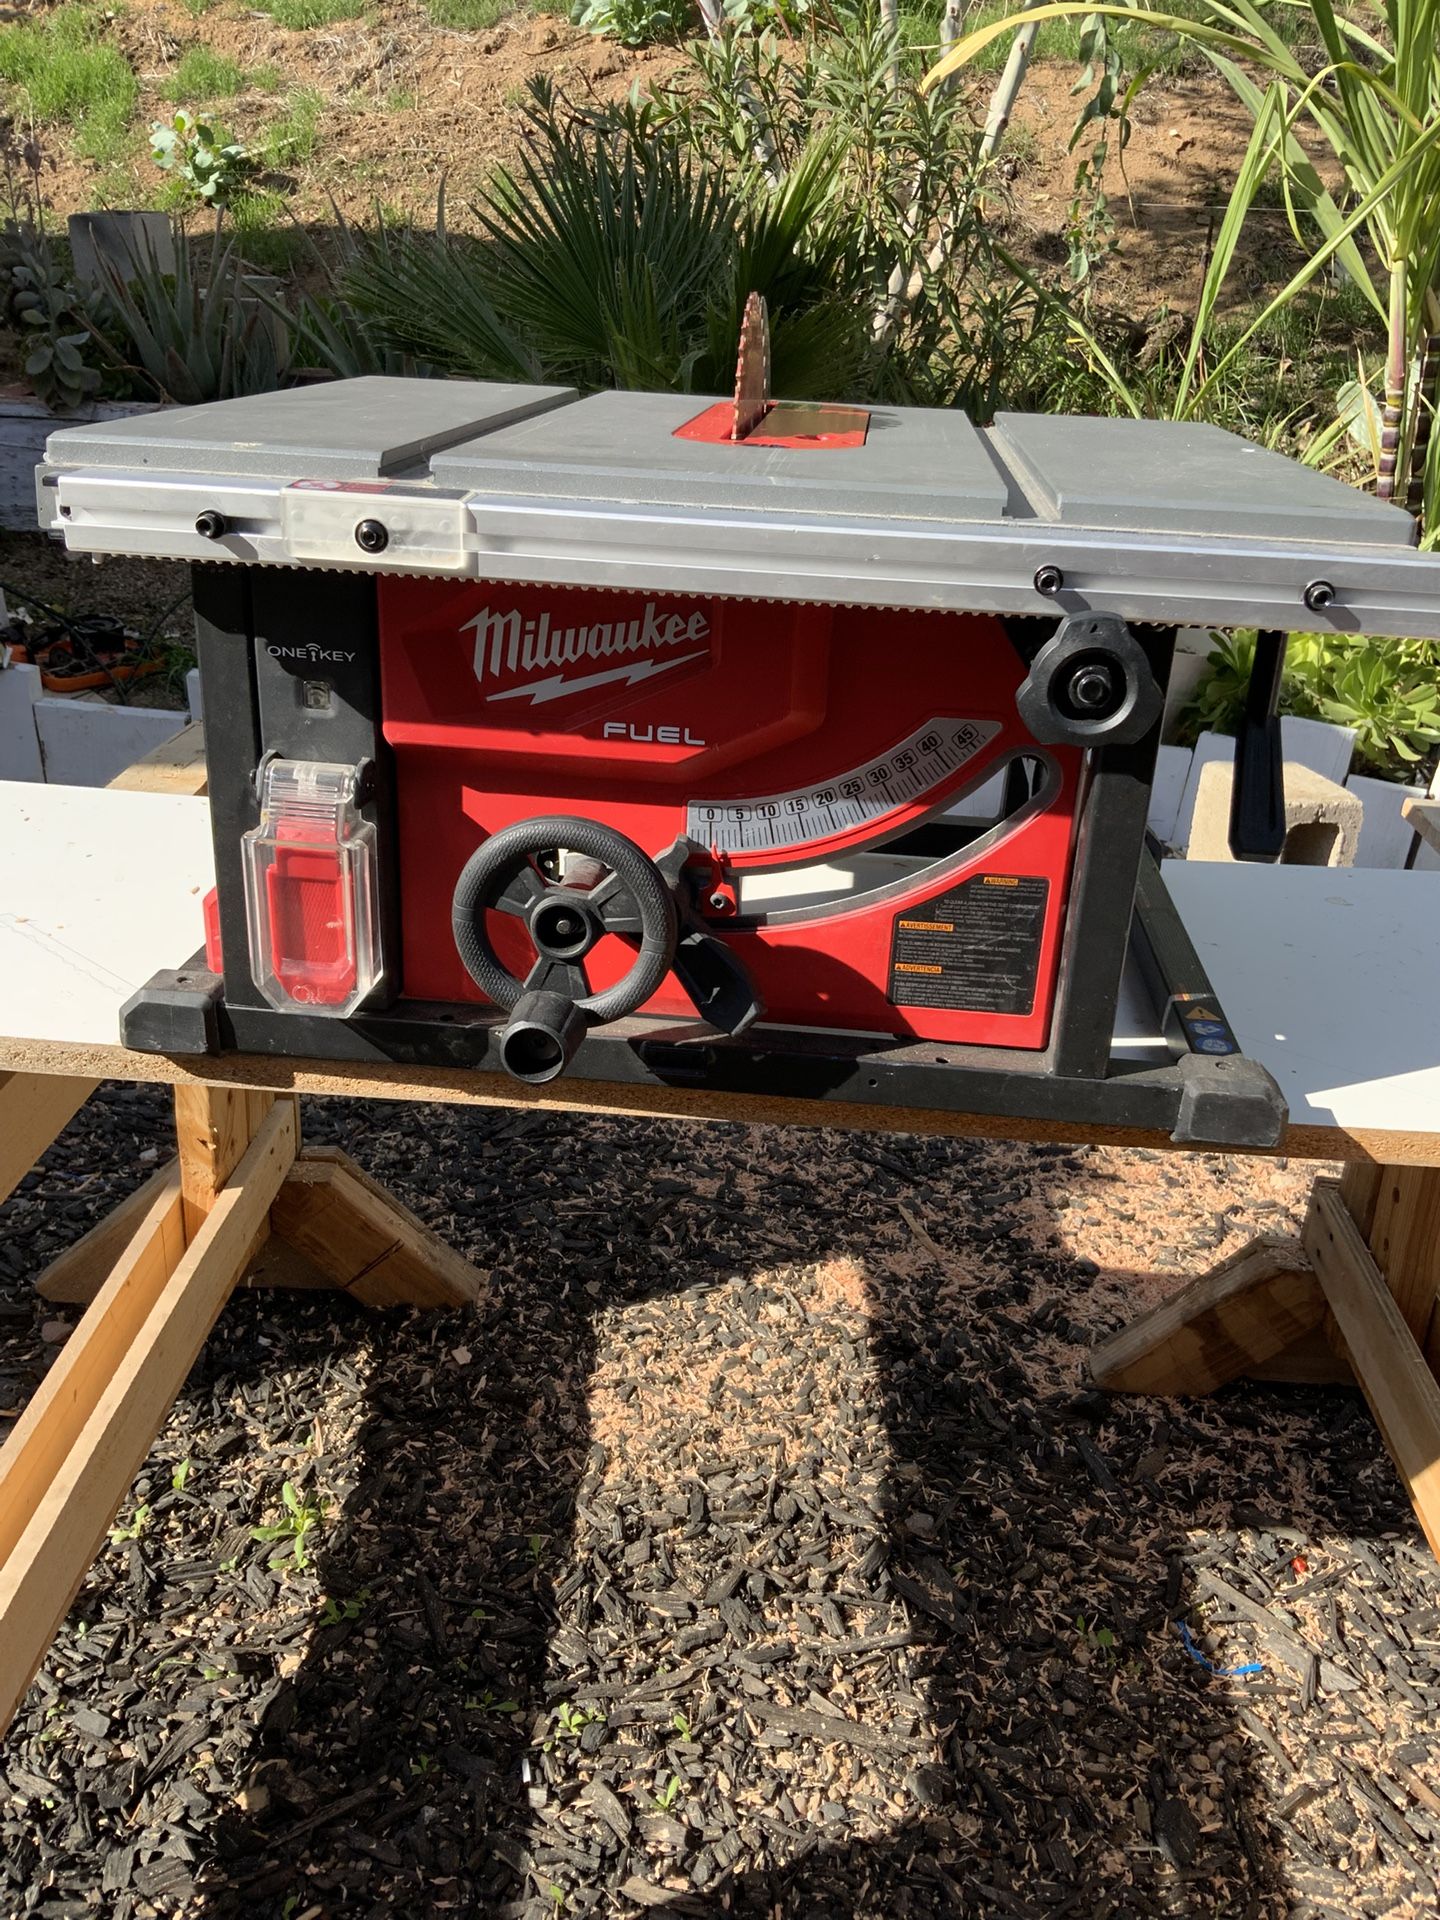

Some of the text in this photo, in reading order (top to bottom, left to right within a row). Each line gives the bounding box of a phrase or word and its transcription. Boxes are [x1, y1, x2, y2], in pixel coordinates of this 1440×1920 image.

[459, 602, 710, 683] Milwaukee
[604, 721, 706, 746] FUEL
[706, 728, 975, 820] 0 5 10 15 20 25 30 35 40 45
[906, 921, 952, 931] AVERTISSEMENT
[902, 964, 940, 974] ADVERTENCIA
